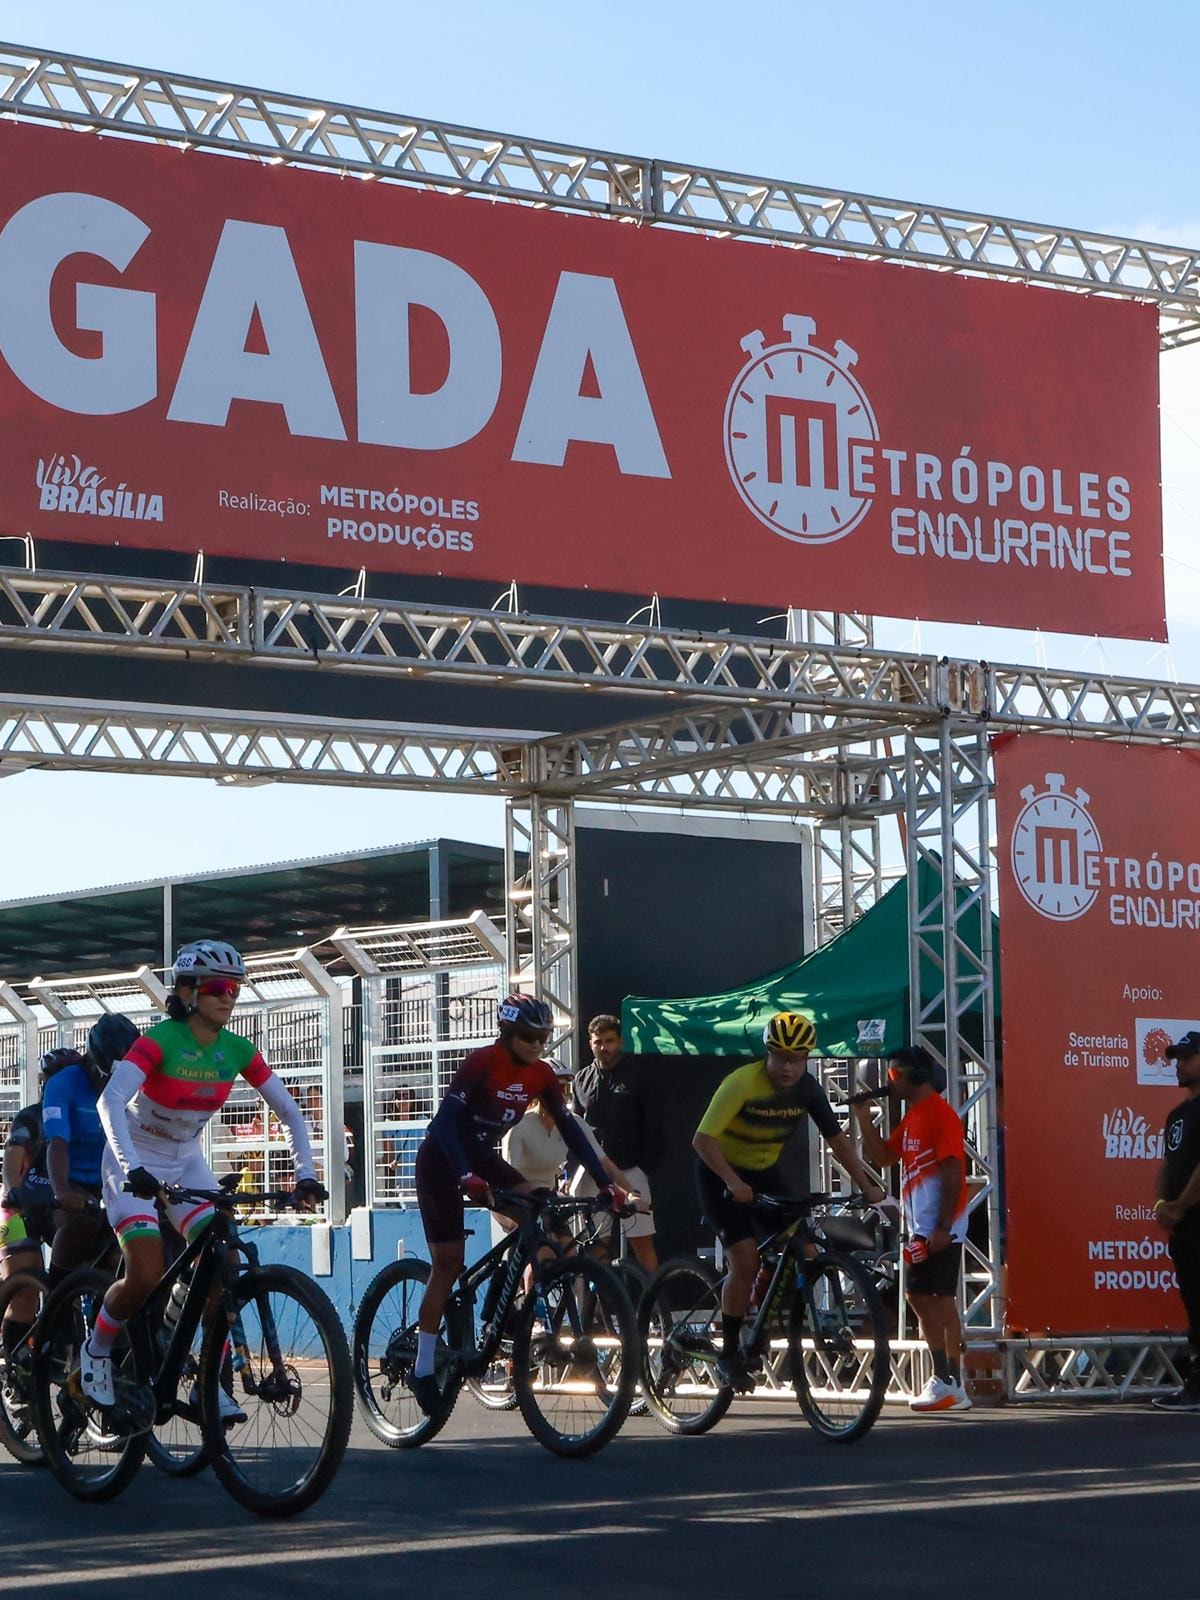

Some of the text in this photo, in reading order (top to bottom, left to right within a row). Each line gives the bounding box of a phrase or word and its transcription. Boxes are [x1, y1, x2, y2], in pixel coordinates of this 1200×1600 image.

[36, 453, 106, 489] Viva
[39, 483, 163, 521] BRASÍLIA
[219, 490, 311, 518] Realização:
[320, 485, 480, 521] METRÓPOLES
[328, 518, 474, 552] PRODUÇÕES
[891, 508, 1131, 577] ENDURANCE
[1122, 984, 1163, 1001] Apoio:
[1069, 1032, 1128, 1049] Secretaria
[1064, 1051, 1129, 1067] de Turismo
[1103, 1107, 1151, 1139] Viva
[1105, 1129, 1165, 1159] BRASÍ
